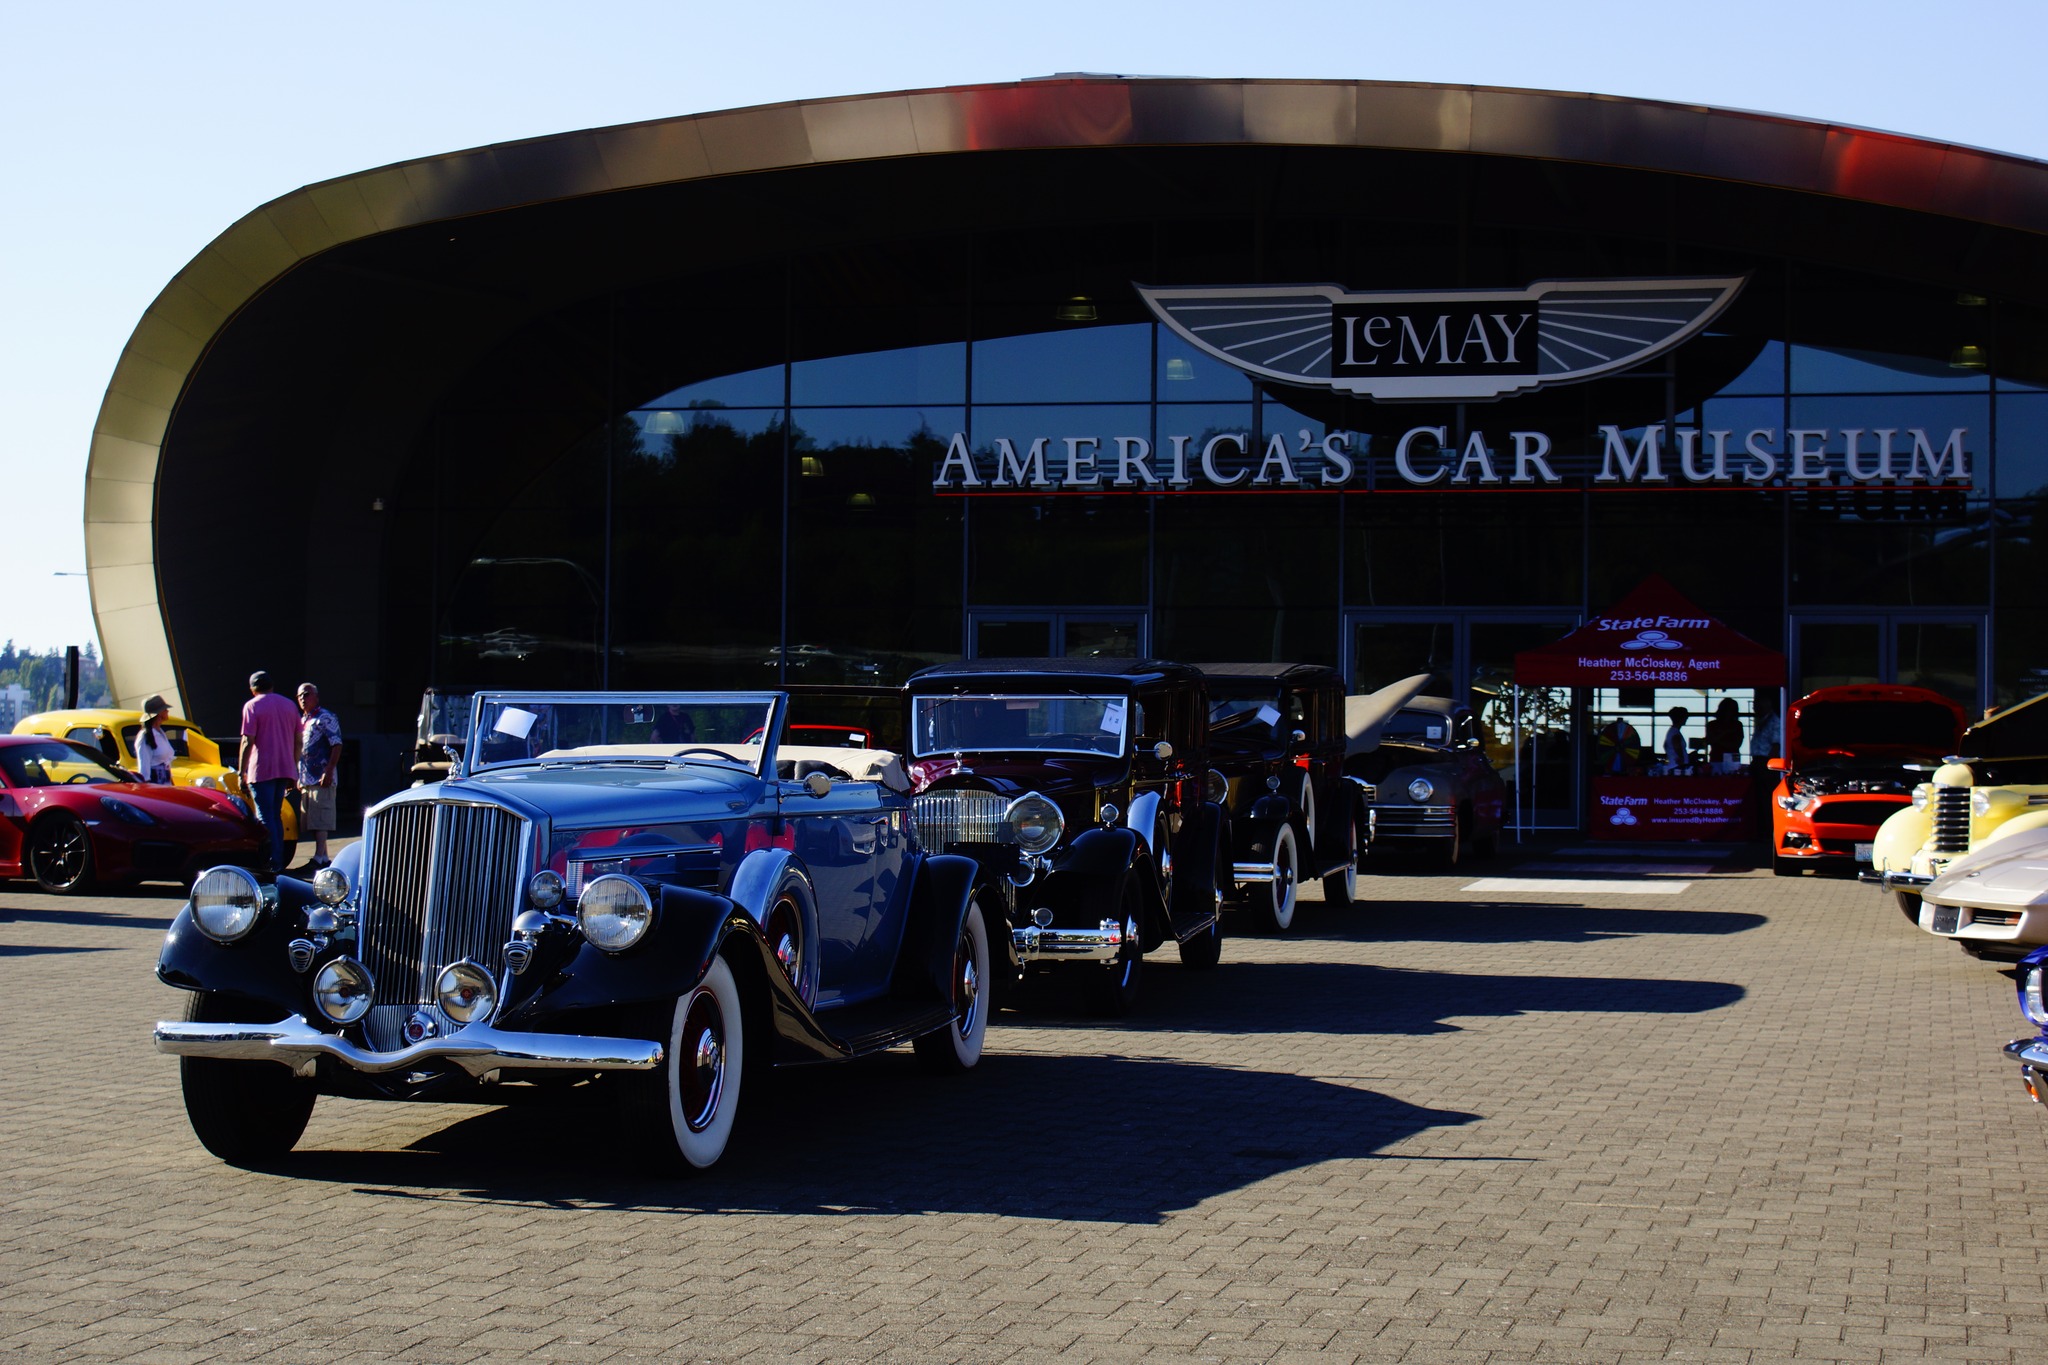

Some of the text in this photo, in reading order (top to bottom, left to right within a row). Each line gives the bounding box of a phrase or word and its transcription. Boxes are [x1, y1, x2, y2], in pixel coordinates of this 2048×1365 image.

[1340, 313, 1533, 366] LeMAY
[933, 424, 1972, 488] AMERICA'S CAR MUSEUM
[1578, 657, 1621, 668] Heather
[1688, 659, 1720, 670] Agent
[1610, 671, 1687, 682] 253-564-8886
[1653, 798, 1681, 806] Heather
